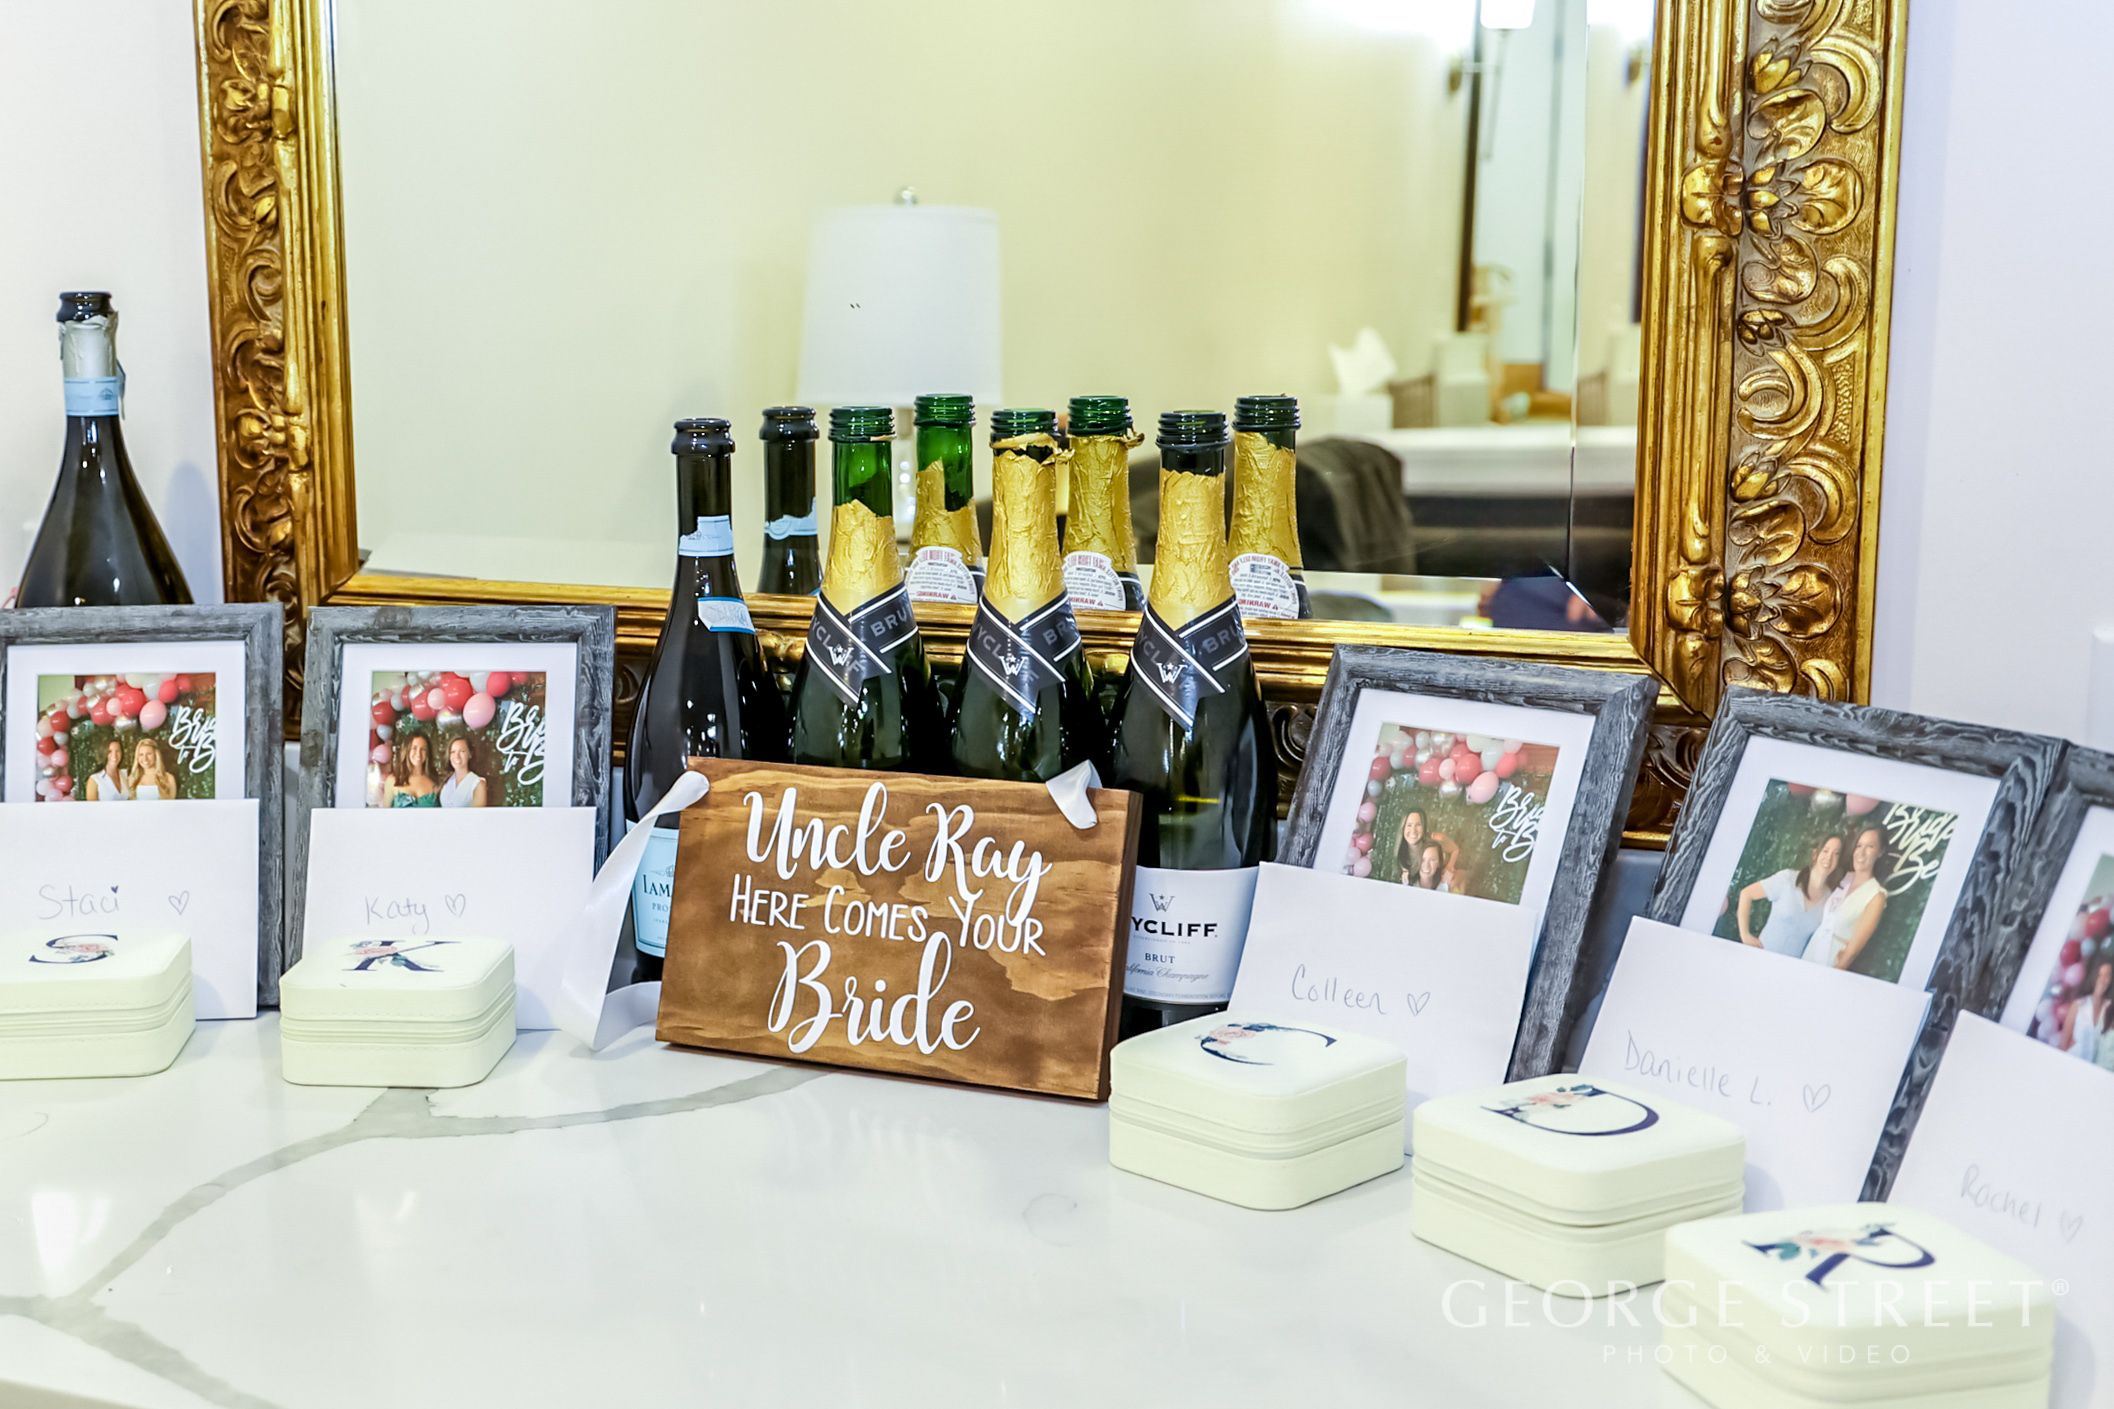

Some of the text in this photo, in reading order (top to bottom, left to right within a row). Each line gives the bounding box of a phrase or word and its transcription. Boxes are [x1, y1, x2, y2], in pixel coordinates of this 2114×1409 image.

[743, 782, 1053, 927] Uncle Ray
[364, 896, 430, 935] Katy
[1145, 952, 1175, 964] BRUT
[768, 931, 981, 1055] Bride
[1292, 964, 1387, 1015] Colleen
[1624, 1029, 1732, 1098] Danielle
